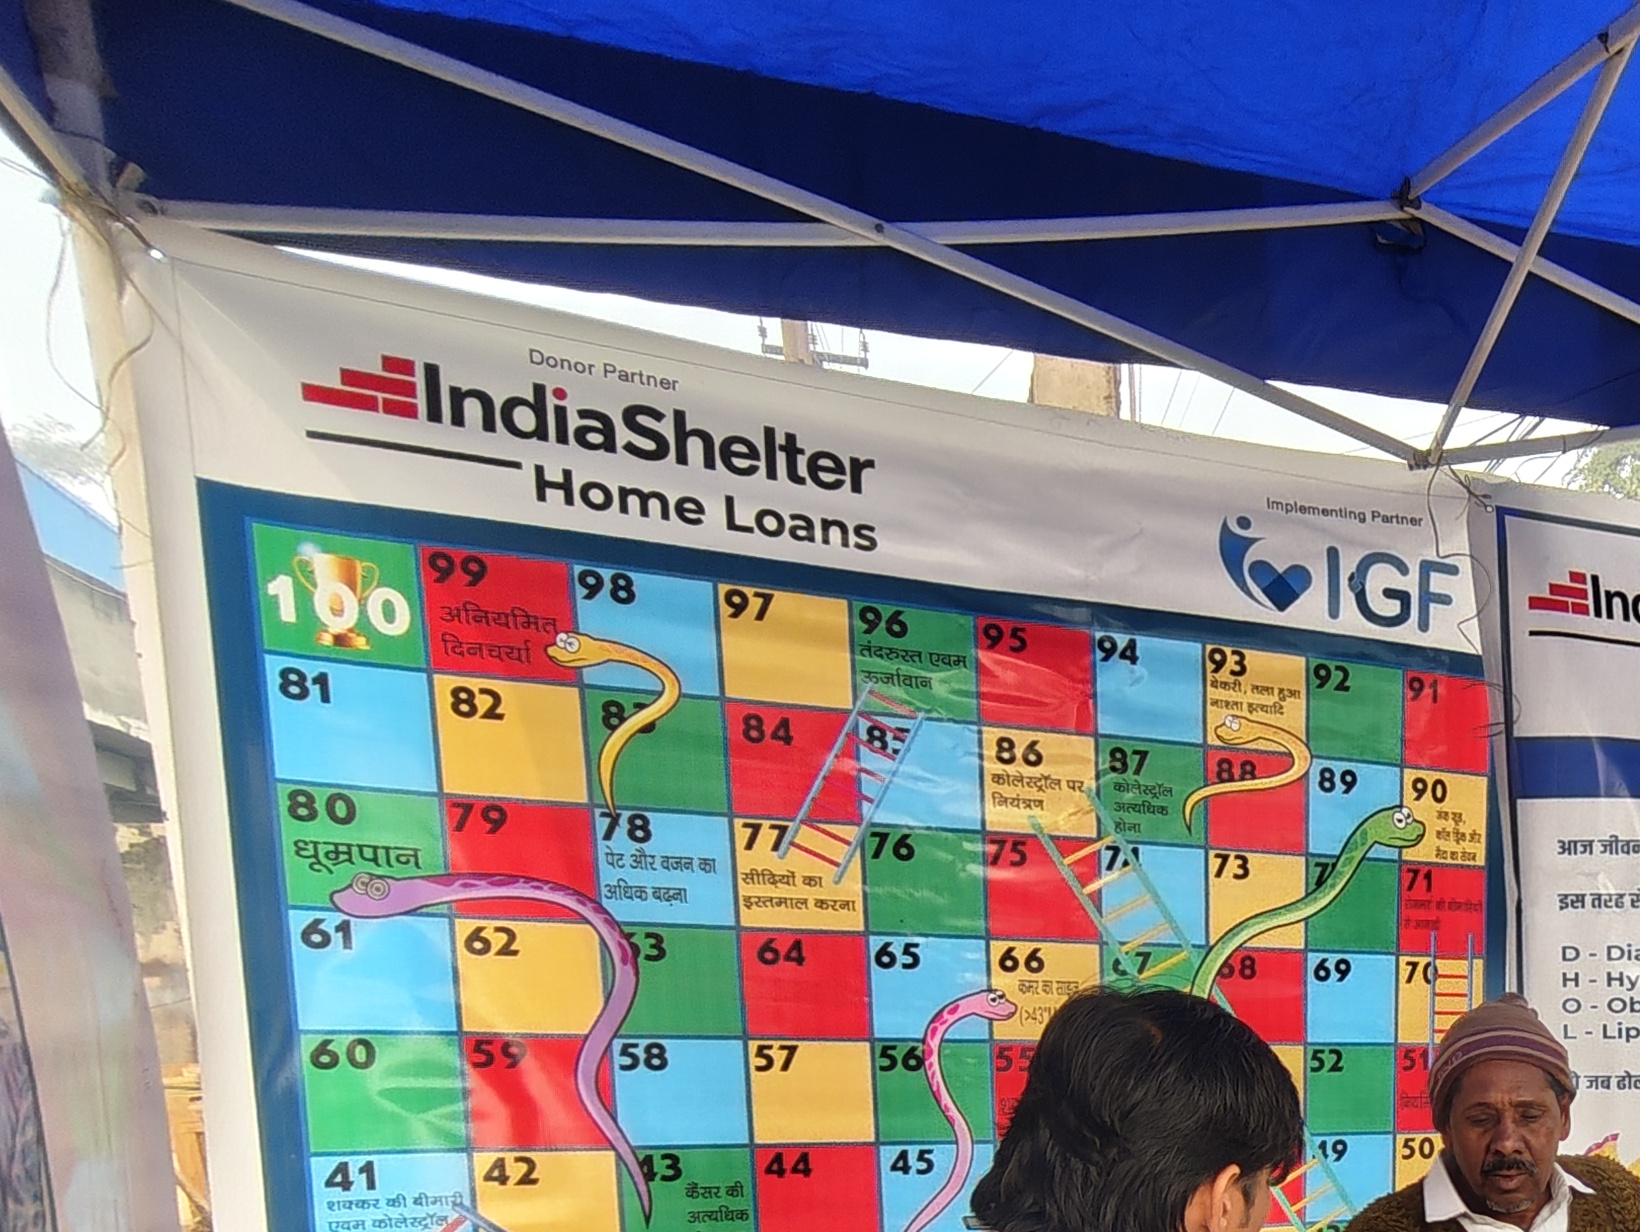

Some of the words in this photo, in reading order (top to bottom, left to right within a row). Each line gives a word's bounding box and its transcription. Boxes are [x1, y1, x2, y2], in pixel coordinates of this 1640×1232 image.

[528, 348, 596, 378] Donor
[602, 362, 680, 393] Partner
[424, 362, 875, 495] IndiaShelter
[534, 464, 706, 526] Home
[724, 492, 879, 553] Loans
[1266, 497, 1366, 524] Implementing
[1371, 510, 1424, 528] Partner
[428, 552, 488, 588] 99
[722, 587, 774, 622] 97
[1326, 545, 1460, 633] IGF
[267, 575, 411, 638] 100
[858, 605, 909, 638] 96
[1097, 634, 1139, 665] 94
[1207, 647, 1247, 677] 93
[277, 667, 331, 705] 81
[1408, 676, 1439, 704] 91
[740, 715, 794, 746] 84
[995, 736, 1043, 768] 86
[1107, 747, 1150, 777] 87
[1412, 777, 1447, 804] 90
[287, 789, 357, 825] 80
[599, 812, 653, 844] 78
[293, 838, 422, 874] धूम्रपान
[870, 831, 915, 862] 76
[988, 839, 1027, 867] 75
[1405, 868, 1433, 893] 71
[300, 918, 353, 950] 61
[874, 941, 920, 970] 65
[998, 946, 1045, 974] 66
[1561, 946, 1581, 962] D
[1313, 958, 1351, 983] 69
[1562, 972, 1580, 988] H
[1561, 998, 1582, 1014] O
[1563, 1024, 1577, 1039] L
[309, 1038, 376, 1070] 60
[472, 1039, 528, 1069] 59
[618, 1042, 669, 1072] 58
[878, 1045, 924, 1072] 56
[1310, 1049, 1344, 1073] 52
[890, 1149, 935, 1176] 45
[1401, 1137, 1435, 1160] 50
[324, 1160, 377, 1191] 41
